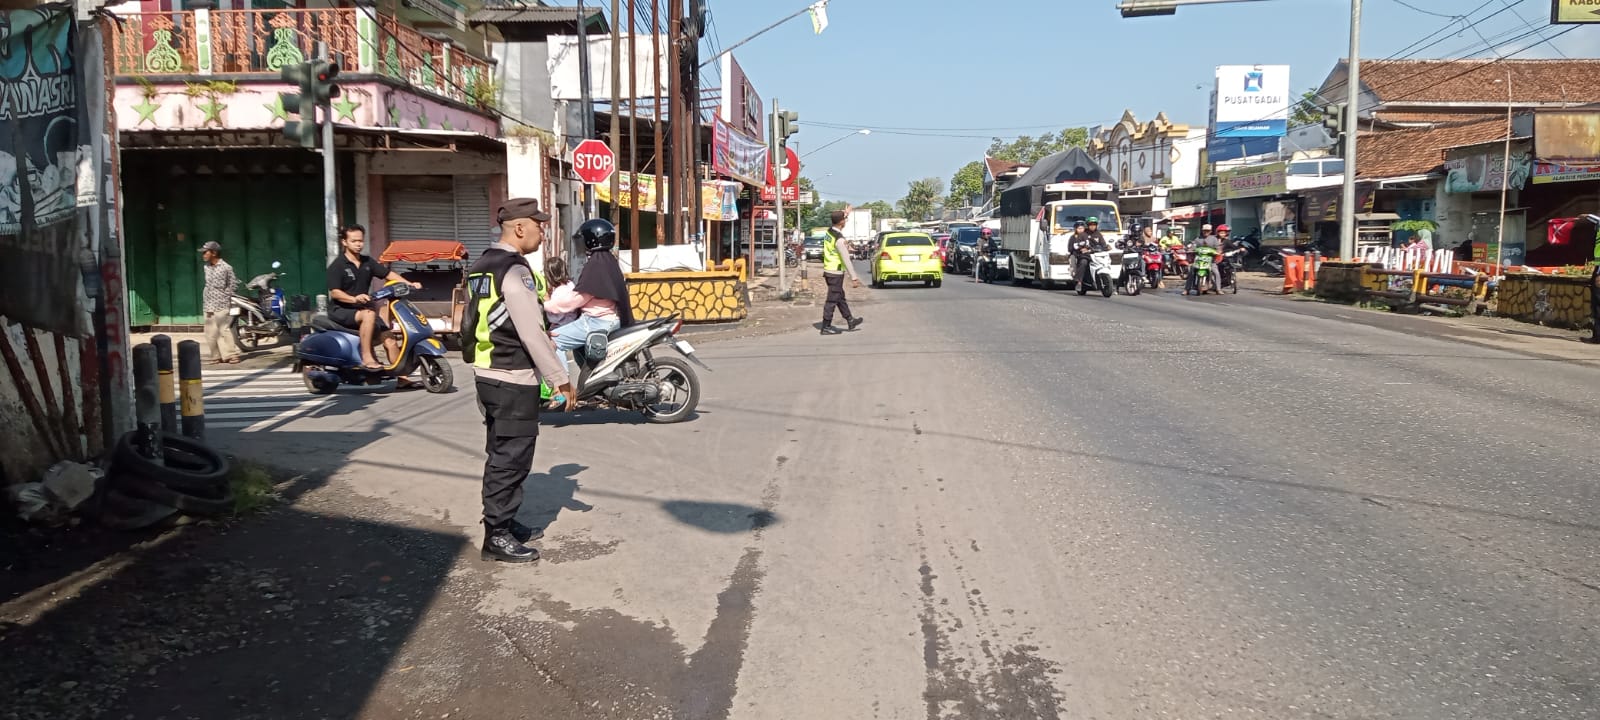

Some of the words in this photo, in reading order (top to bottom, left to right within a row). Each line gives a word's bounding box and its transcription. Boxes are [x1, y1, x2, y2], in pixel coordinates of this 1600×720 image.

[1225, 95, 1253, 104] PUSAT
[1255, 95, 1281, 104] GADAI
[575, 153, 612, 170] STOP
[765, 186, 795, 195] MIUE
